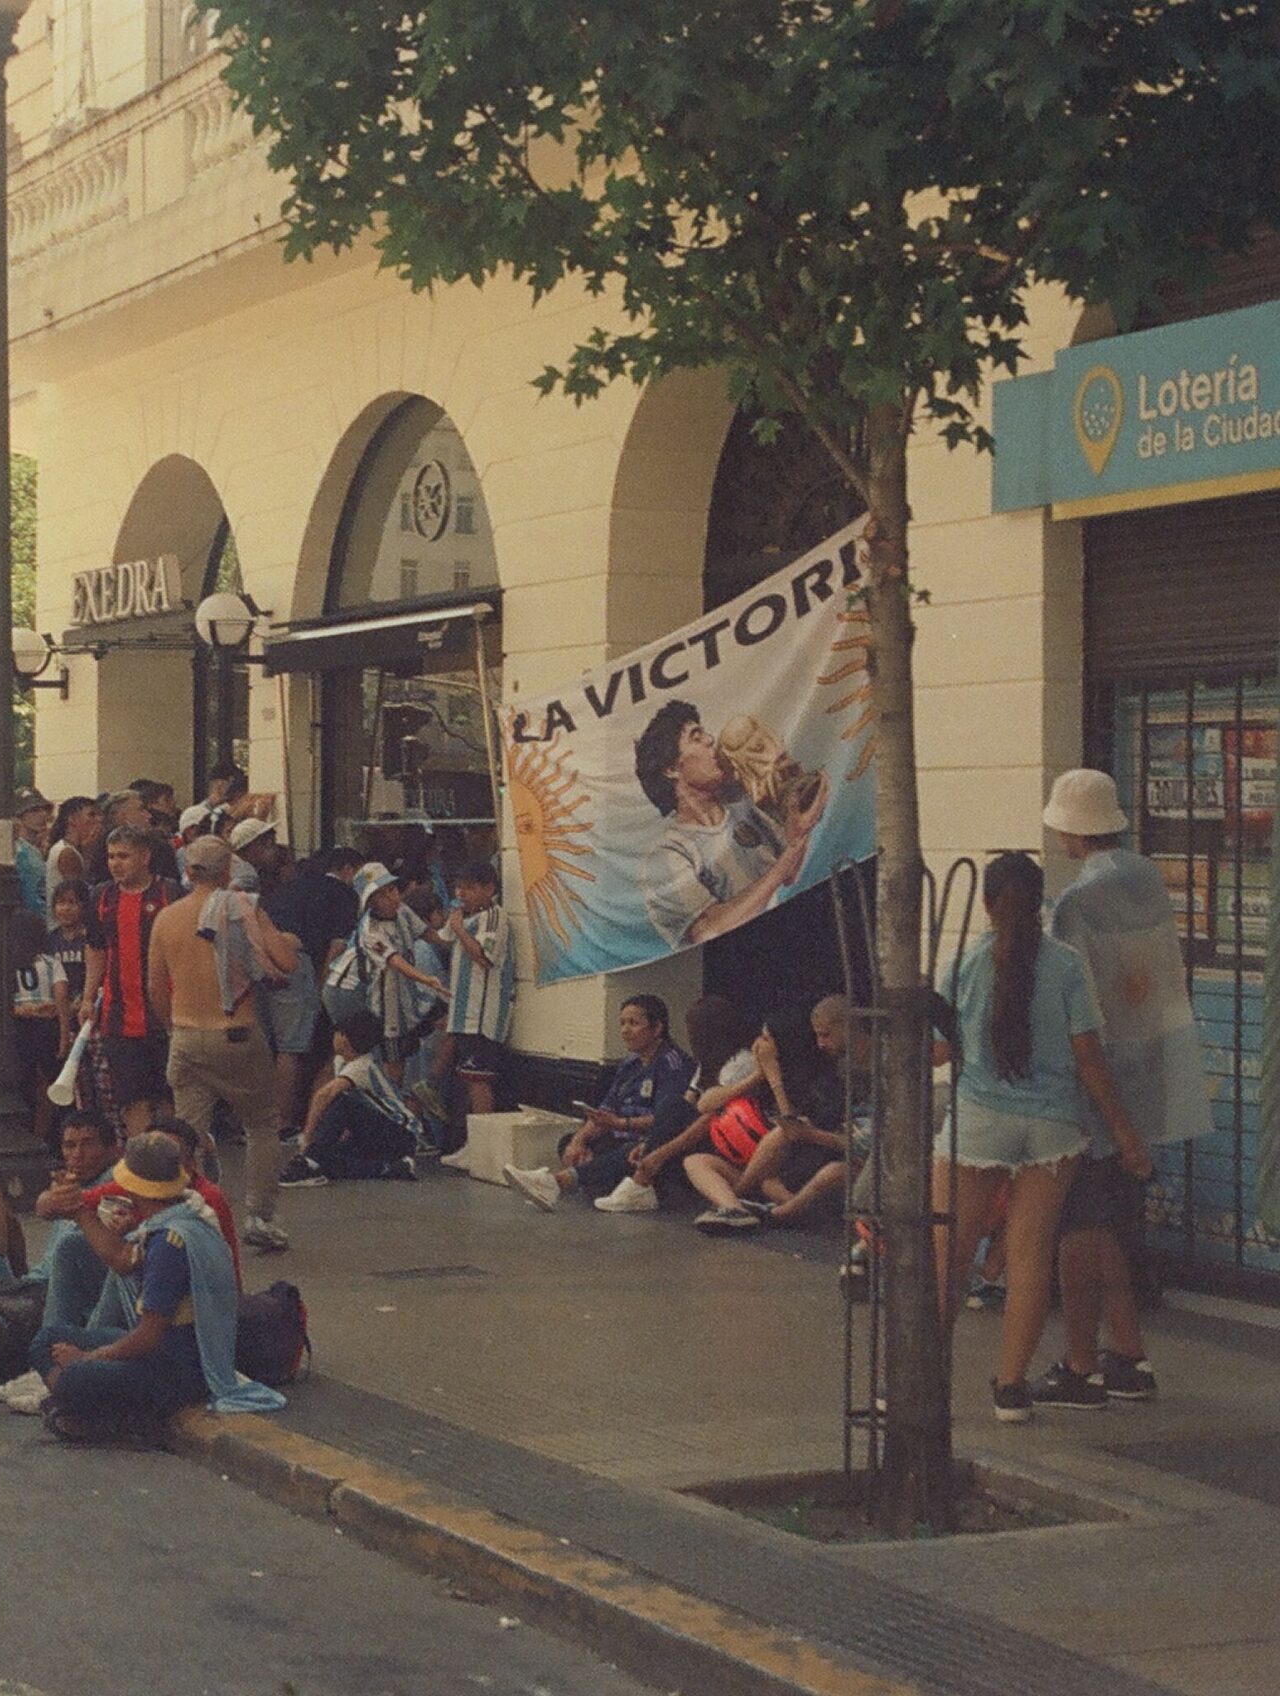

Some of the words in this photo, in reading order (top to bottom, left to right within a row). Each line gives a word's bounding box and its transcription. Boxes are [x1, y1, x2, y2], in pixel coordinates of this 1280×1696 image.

[1137, 353, 1260, 422] Lotería
[1136, 426, 1168, 459] de
[1175, 419, 1195, 452] la
[69, 556, 172, 626] EXEDRA
[512, 700, 577, 744] LA
[583, 540, 862, 719] VICTORI
